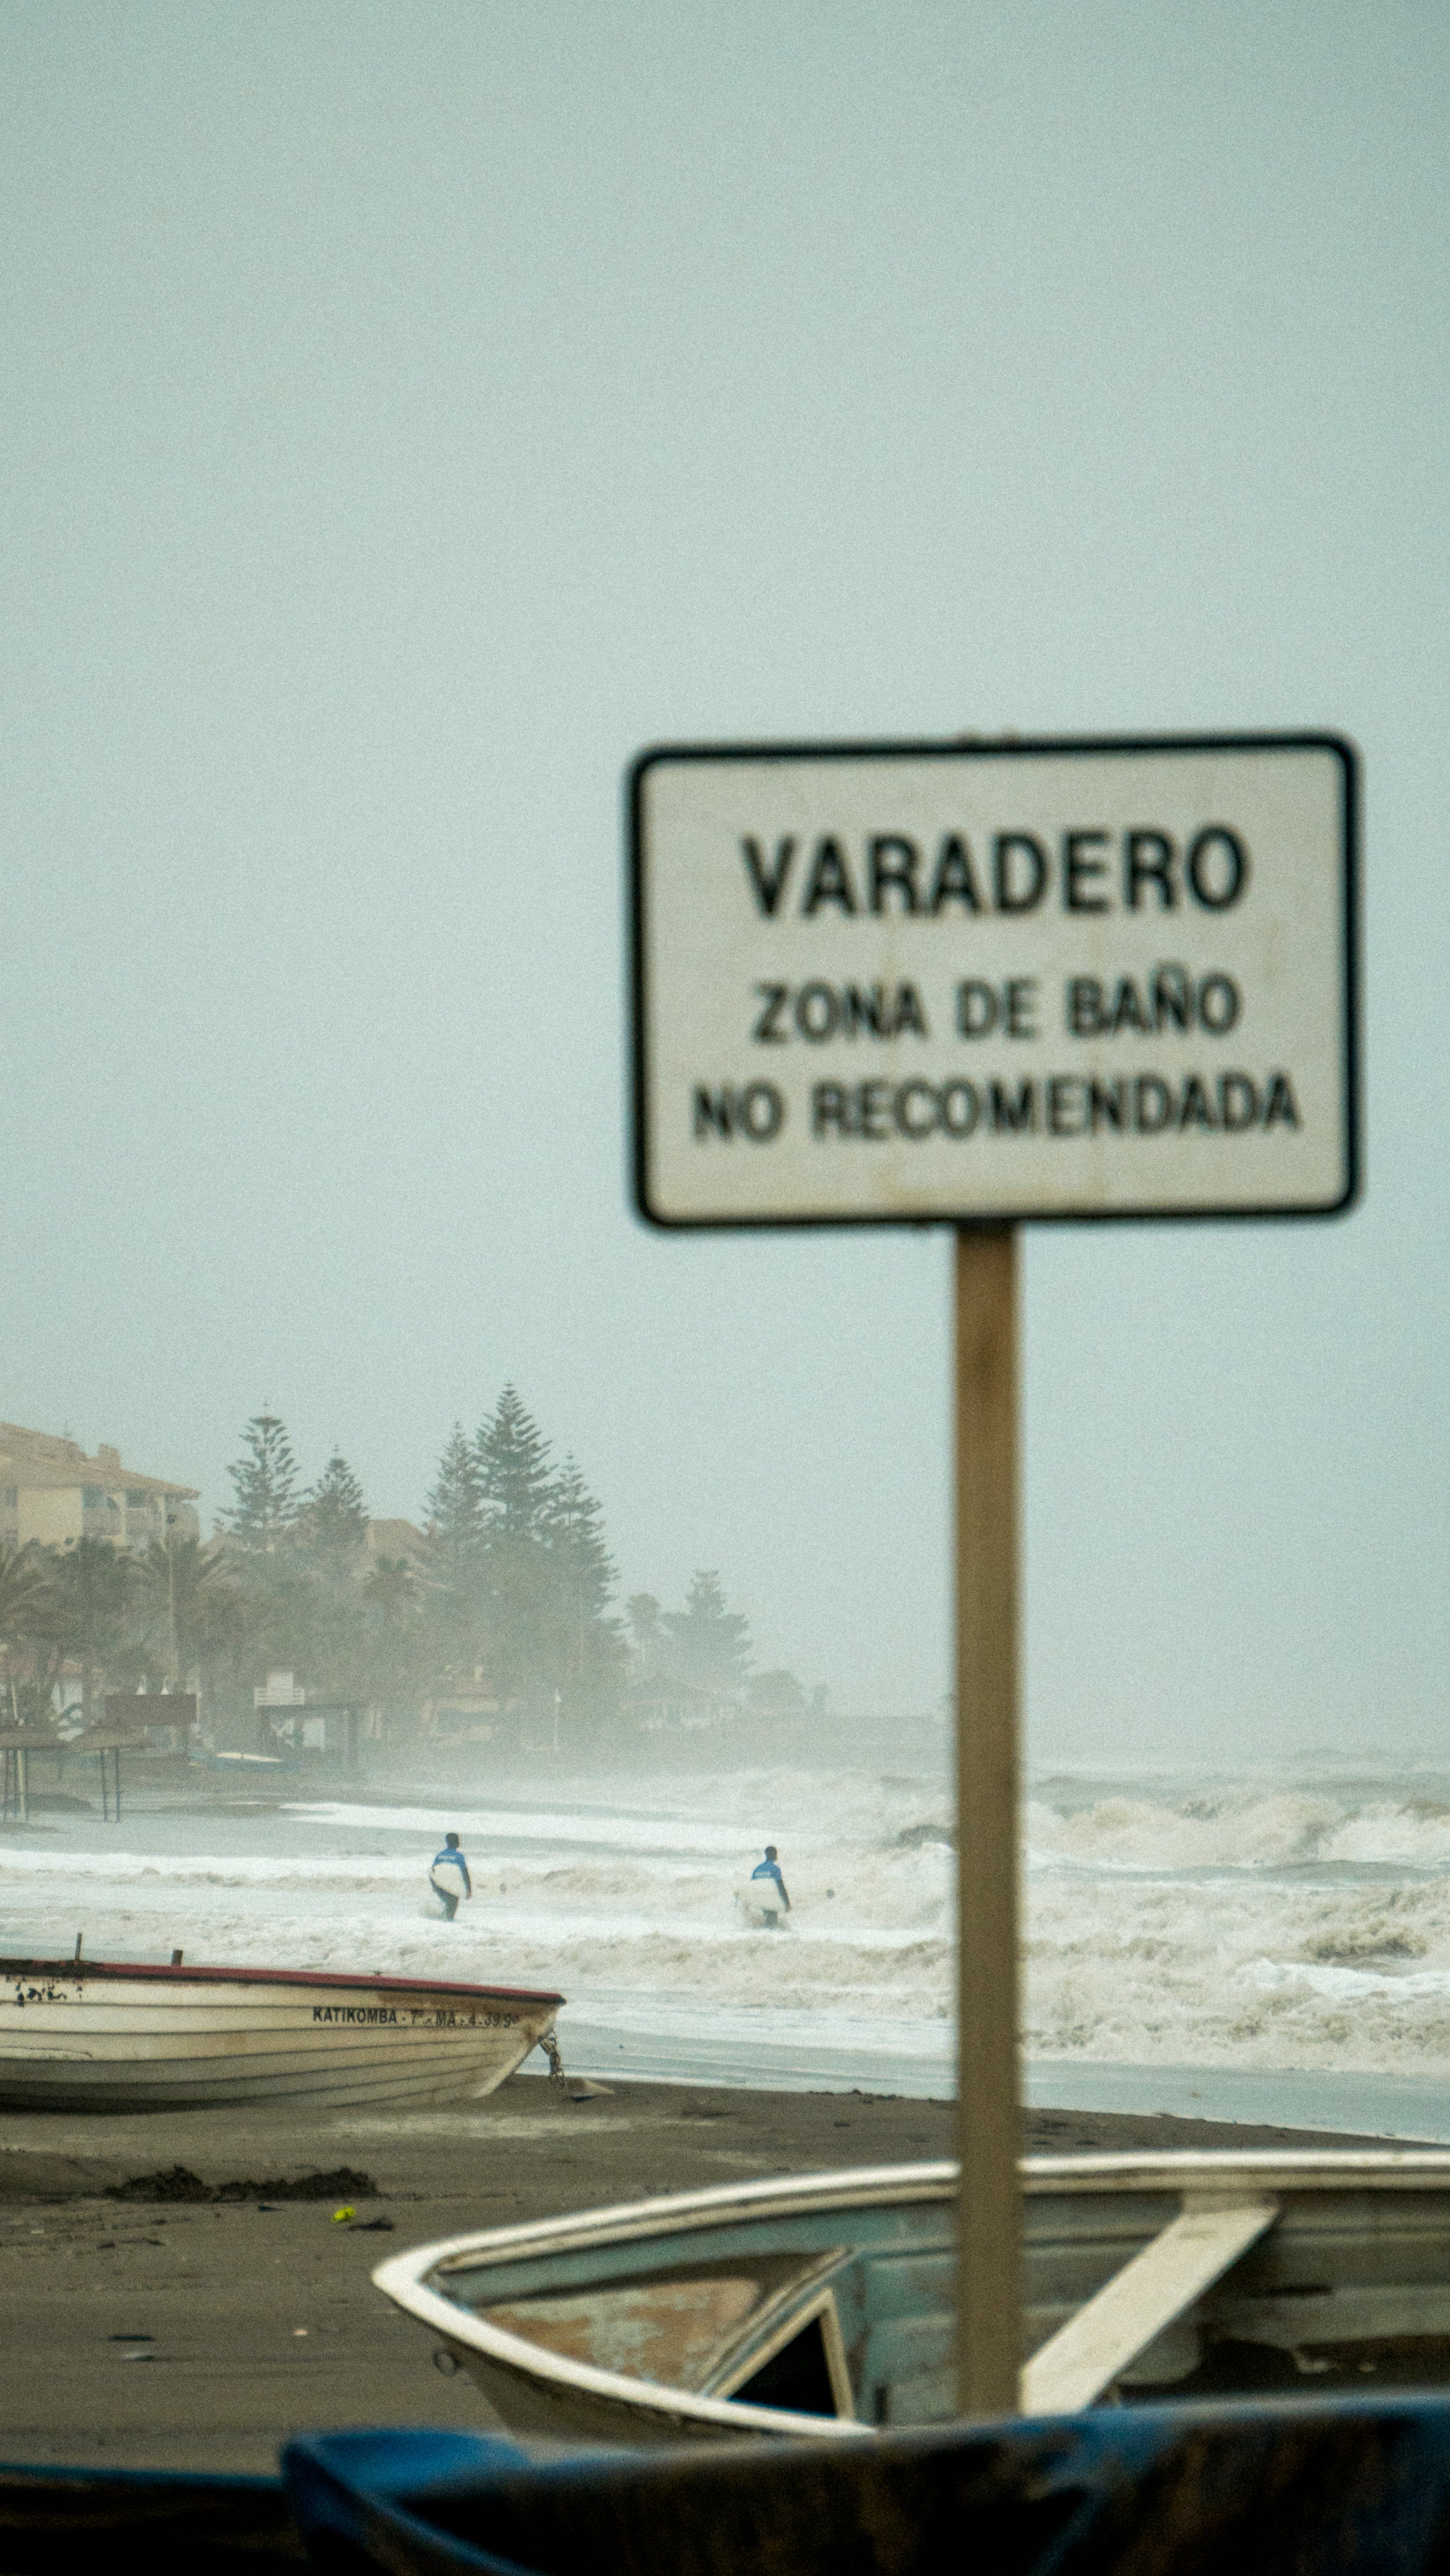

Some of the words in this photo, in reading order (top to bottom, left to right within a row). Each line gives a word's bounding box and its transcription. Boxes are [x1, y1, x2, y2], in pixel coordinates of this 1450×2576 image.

[739, 821, 1251, 922] VARADERO
[751, 980, 928, 1046] ZONA
[955, 977, 1038, 1041] DE
[1064, 960, 1243, 1039] BAÑO
[692, 1079, 787, 1144] NO
[810, 1069, 1303, 1144] RECOMENDADA
[313, 2006, 397, 2025] KATIKOMBA
